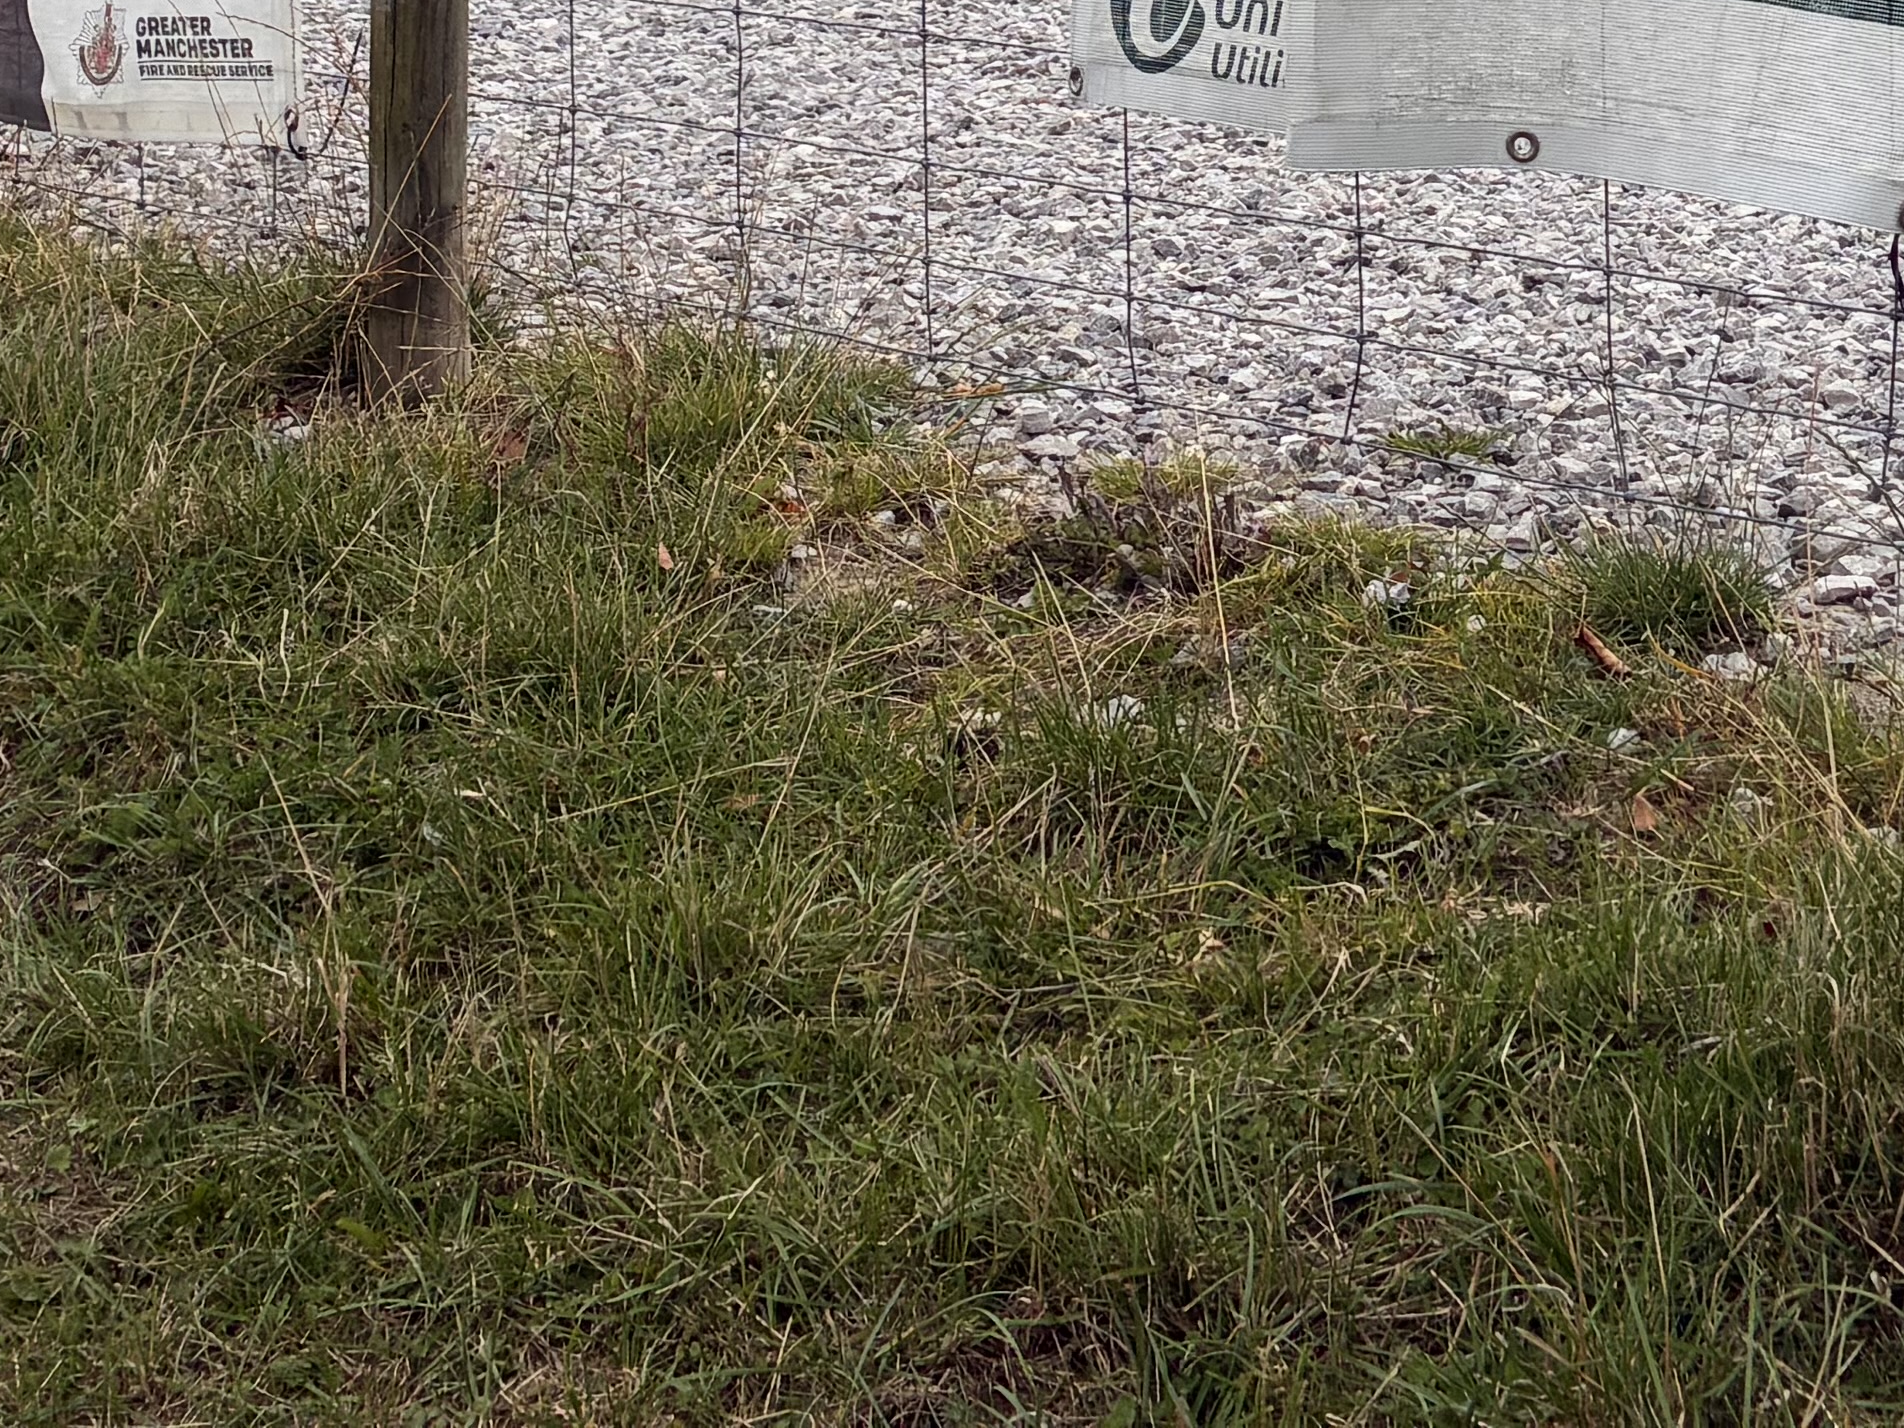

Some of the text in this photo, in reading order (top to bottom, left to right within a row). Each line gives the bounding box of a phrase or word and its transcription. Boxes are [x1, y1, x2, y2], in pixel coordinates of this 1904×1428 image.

[136, 16, 212, 37] GREATER
[137, 38, 254, 59] MANCHESTER
[139, 63, 274, 78] FIRE AND RESCUE SERVICE
[1211, 43, 1285, 88] Utili
